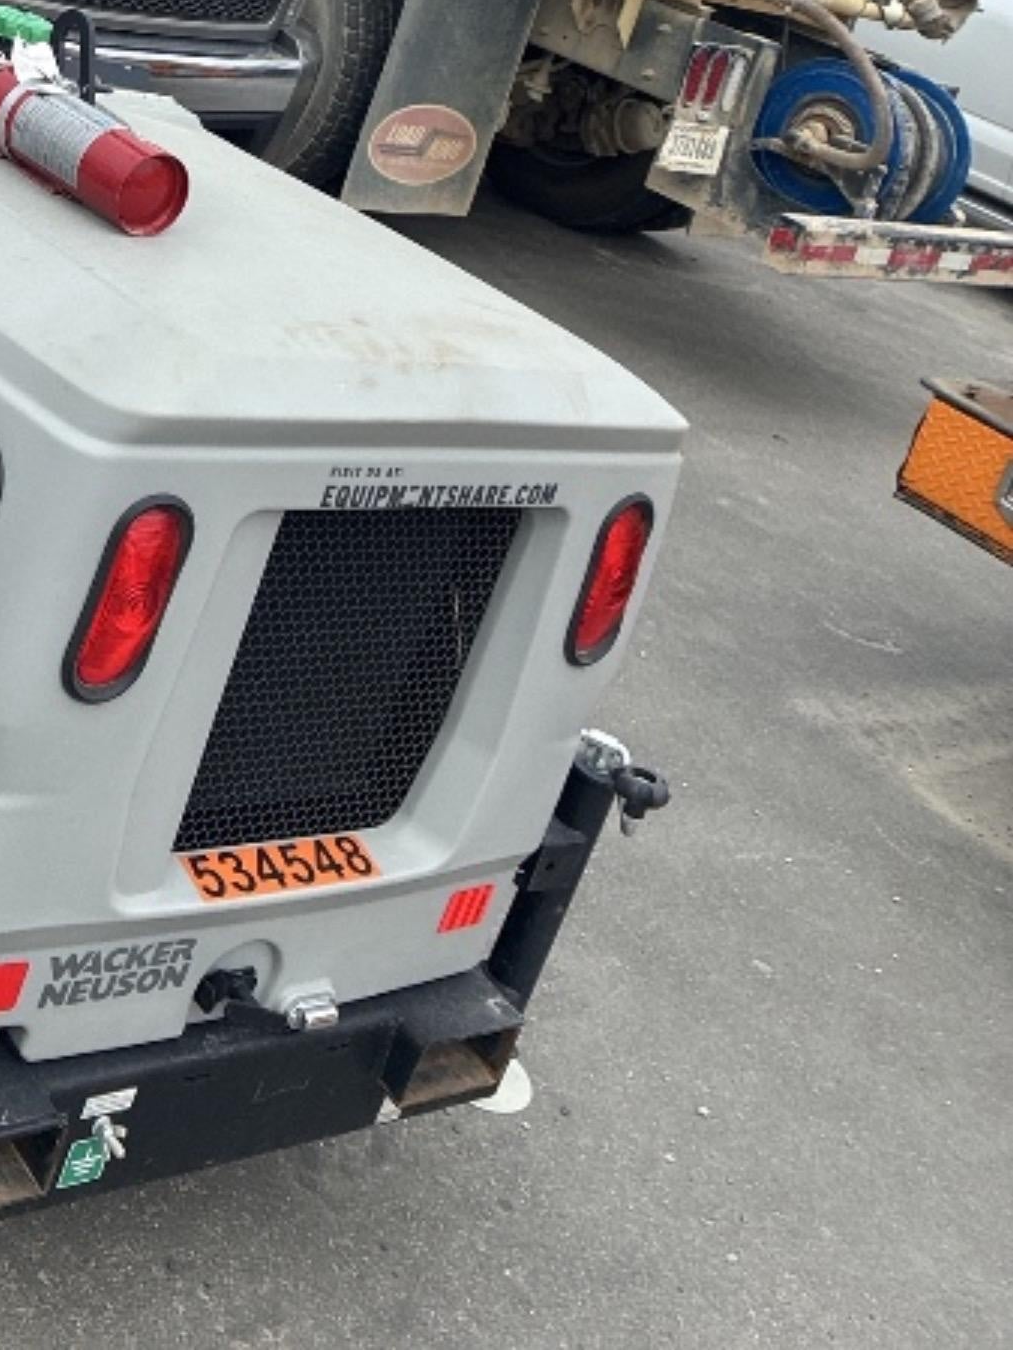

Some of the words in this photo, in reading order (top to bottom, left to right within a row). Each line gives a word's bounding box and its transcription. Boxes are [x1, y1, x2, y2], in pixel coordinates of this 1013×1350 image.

[188, 835, 373, 899] 534548
[49, 938, 197, 982] WACKER
[37, 964, 190, 1010] NEUSON
